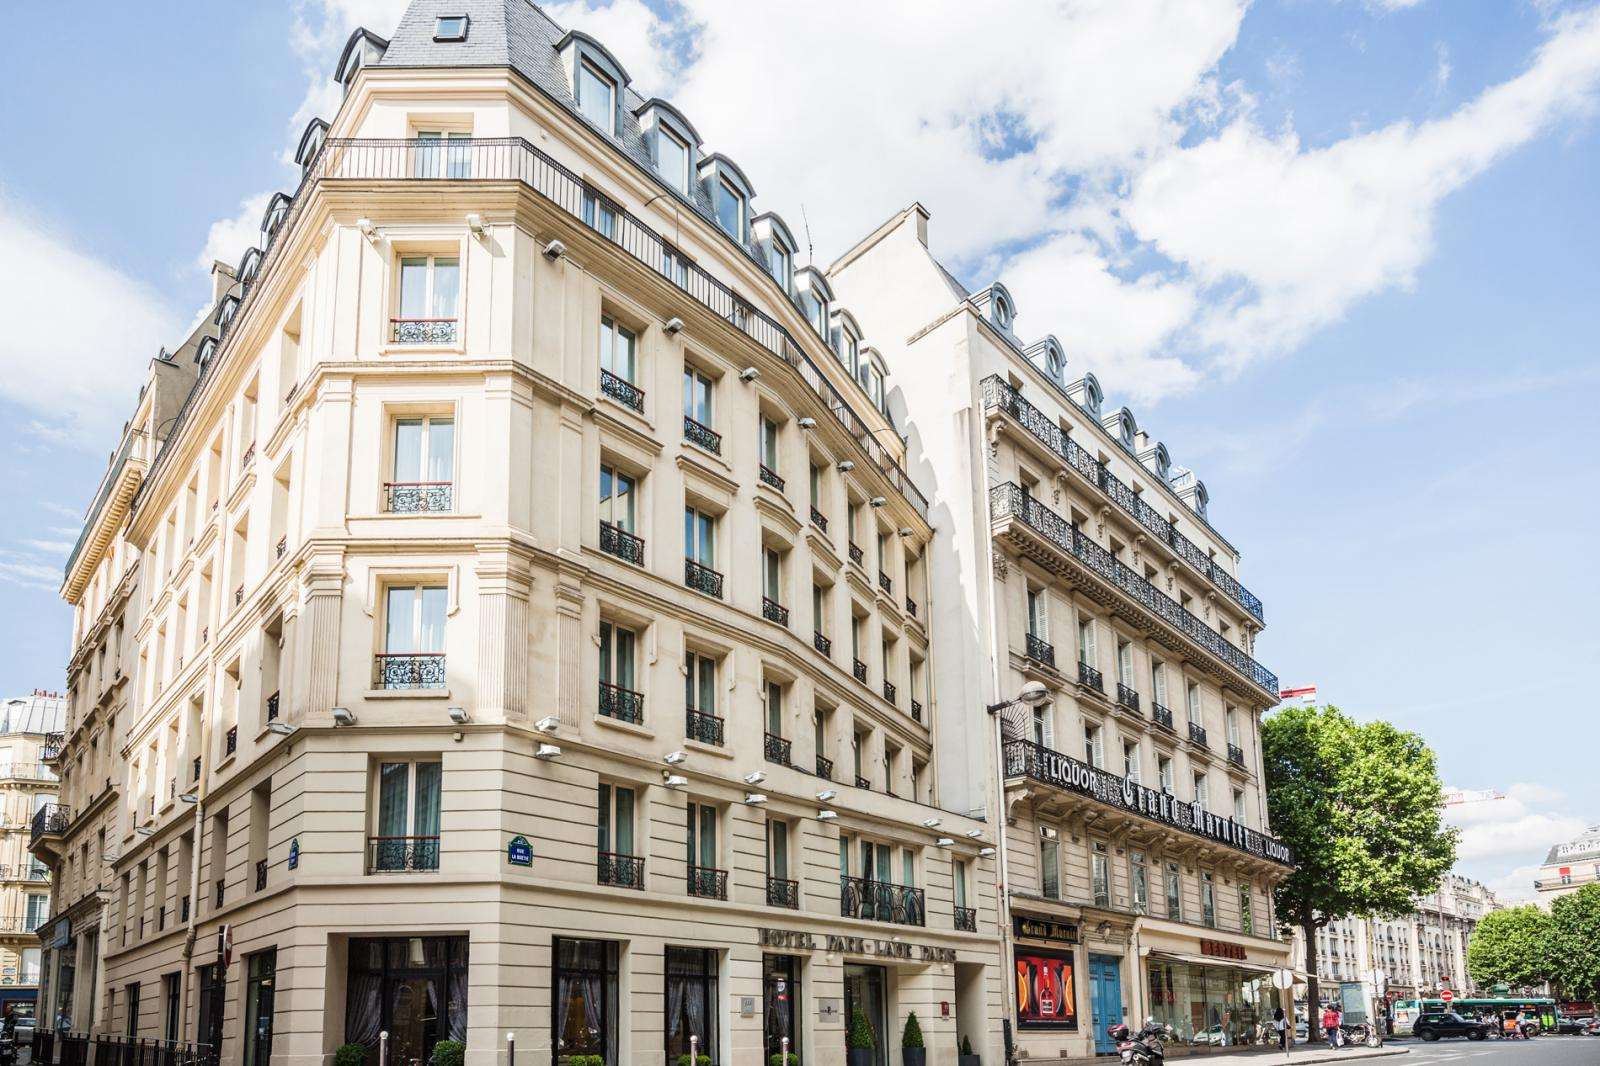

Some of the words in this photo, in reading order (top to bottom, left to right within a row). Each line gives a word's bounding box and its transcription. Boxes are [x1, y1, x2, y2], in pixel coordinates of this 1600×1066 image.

[1051, 757, 1097, 793] LIQUOR
[1266, 841, 1290, 863] LIQUOR
[758, 928, 815, 949] HOTEL
[826, 935, 865, 954] PARK
[920, 946, 957, 963] PARIS
